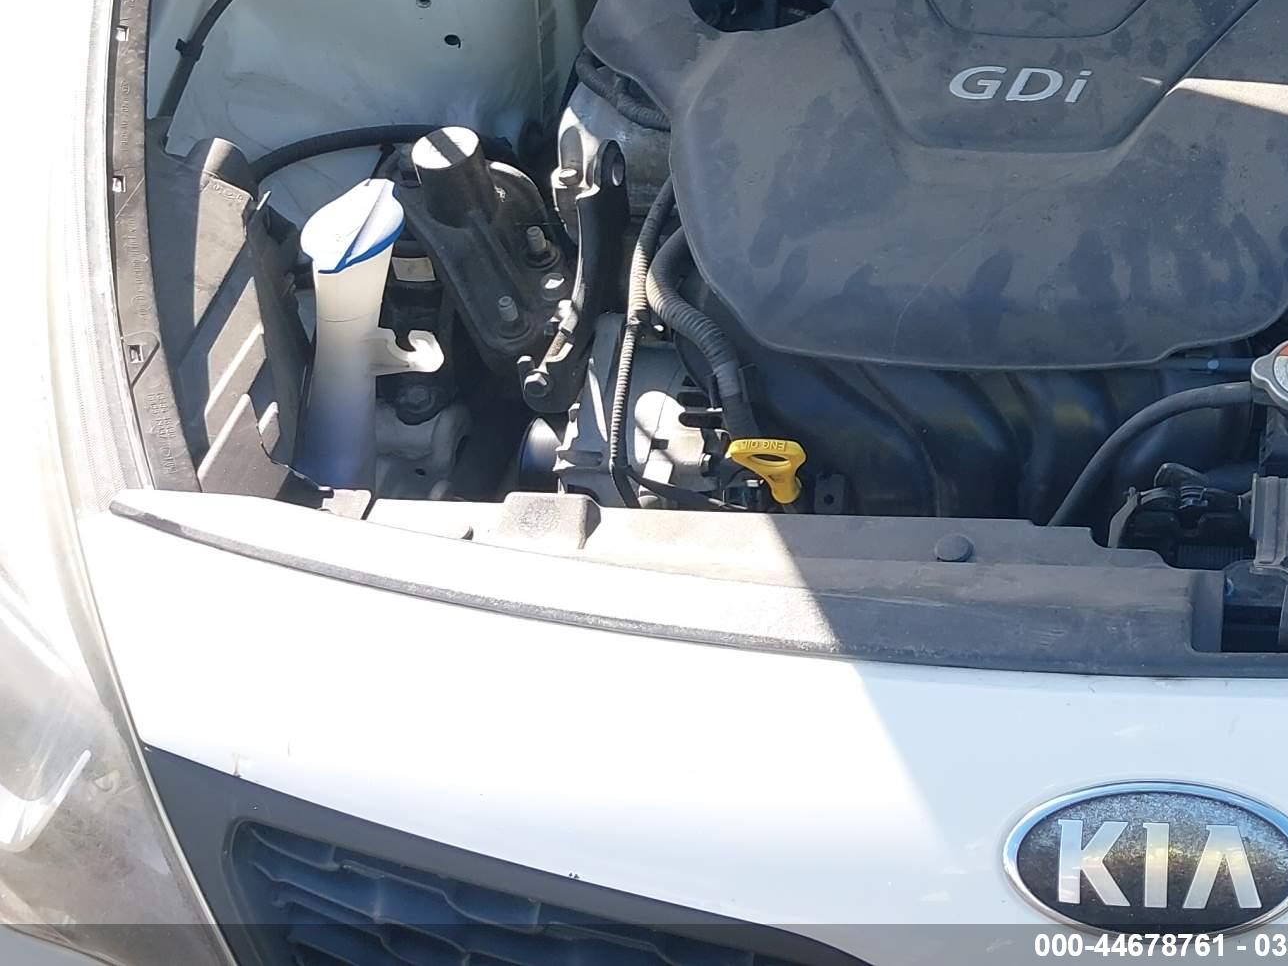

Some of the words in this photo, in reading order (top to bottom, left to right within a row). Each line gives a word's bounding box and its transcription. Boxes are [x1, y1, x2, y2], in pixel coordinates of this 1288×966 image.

[949, 66, 1092, 103] GDi
[743, 440, 759, 450] OIL
[763, 441, 787, 452] ENG
[1057, 819, 1262, 909] KIA
